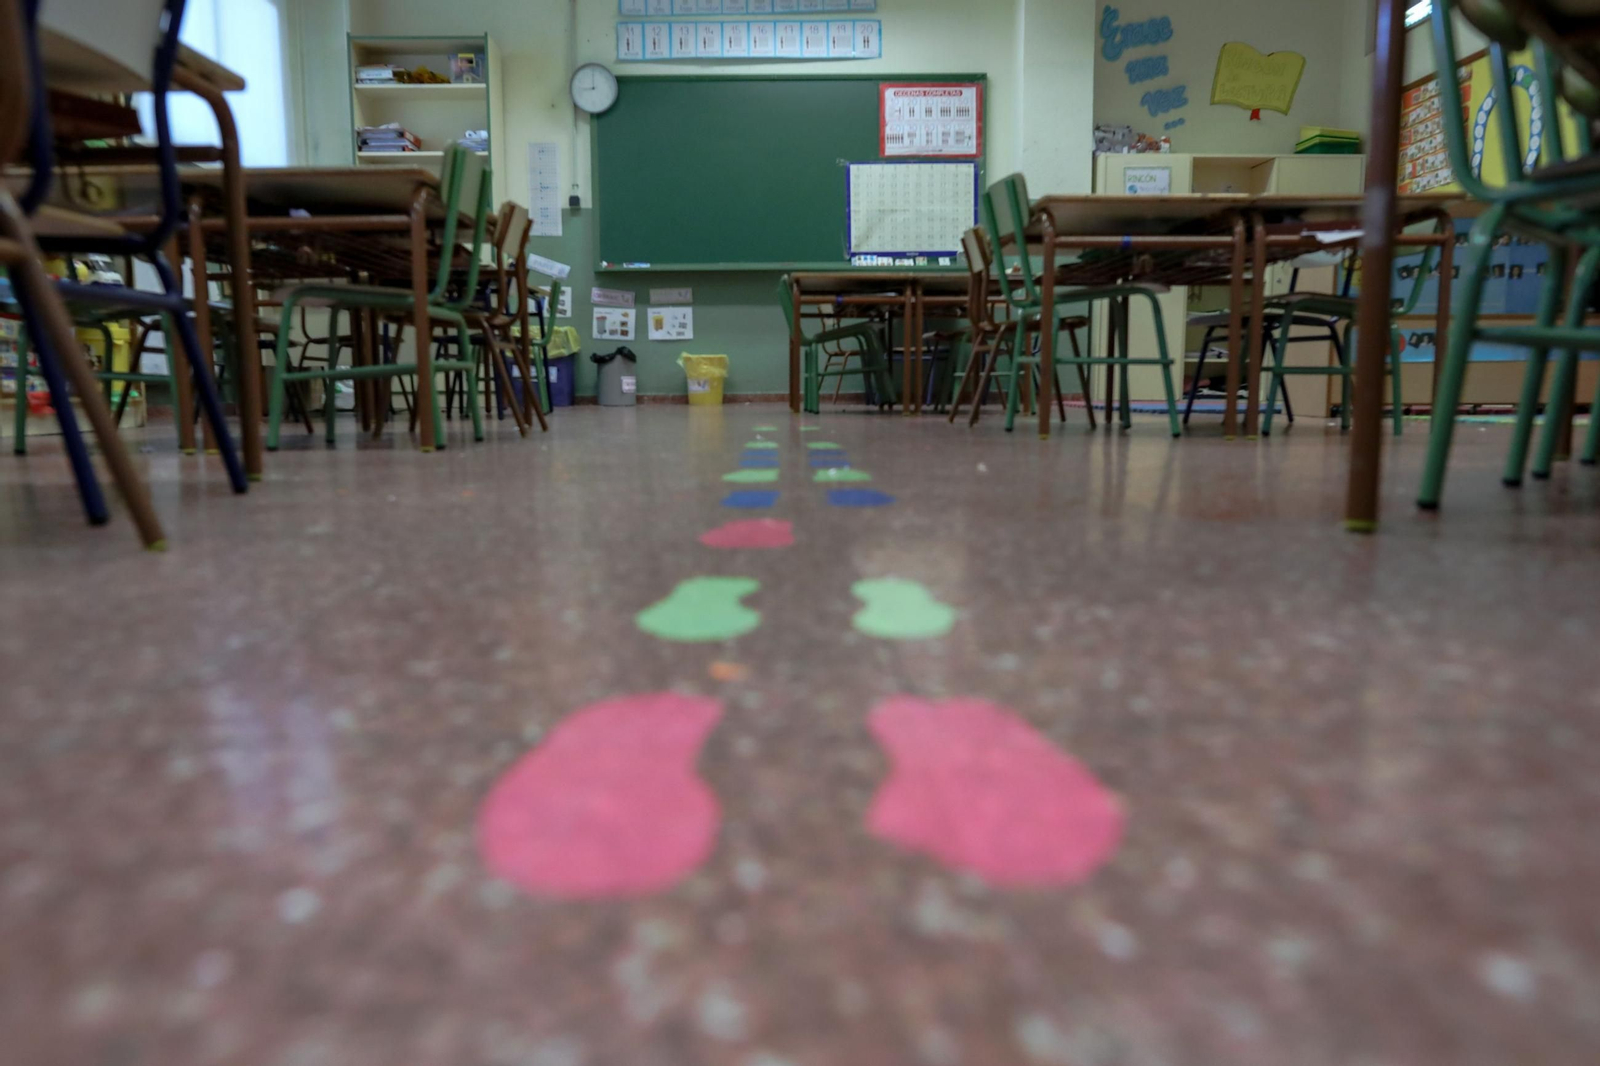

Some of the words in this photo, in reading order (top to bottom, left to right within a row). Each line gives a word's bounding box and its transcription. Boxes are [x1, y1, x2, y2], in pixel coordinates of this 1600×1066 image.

[652, 26, 662, 36] 12
[679, 26, 689, 35] 13
[705, 26, 714, 35] 14
[731, 25, 741, 34] 15
[757, 25, 768, 35] 16
[784, 25, 794, 34] 17
[809, 25, 819, 35] 18
[836, 24, 846, 33] 19
[860, 24, 873, 34] 20
